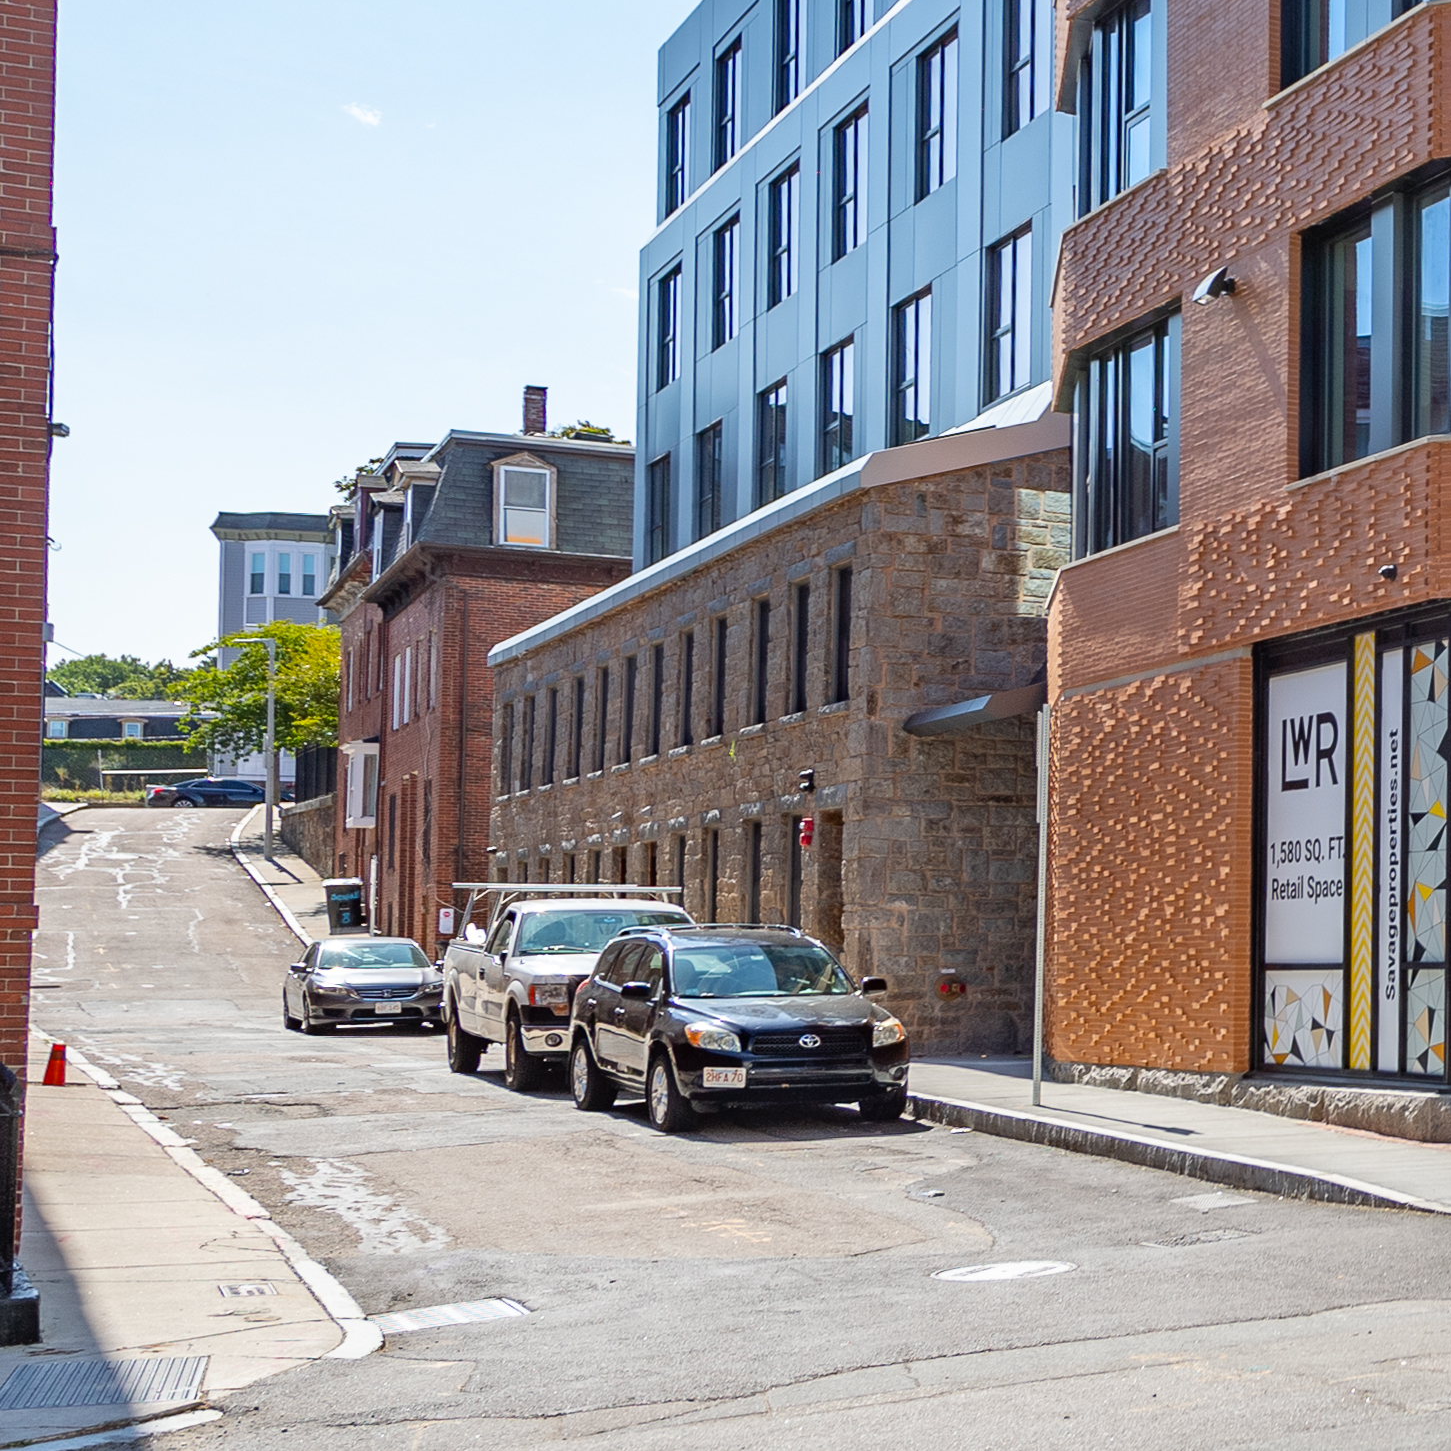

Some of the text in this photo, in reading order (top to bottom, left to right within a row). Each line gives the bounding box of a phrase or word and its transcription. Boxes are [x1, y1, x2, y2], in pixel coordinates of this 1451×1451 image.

[1281, 712, 1339, 792] LWR
[1270, 835, 1346, 869] 1,580 SQ. FT.
[1385, 728, 1399, 1000] Savageproperties.net
[1271, 875, 1343, 904] Retail Space
